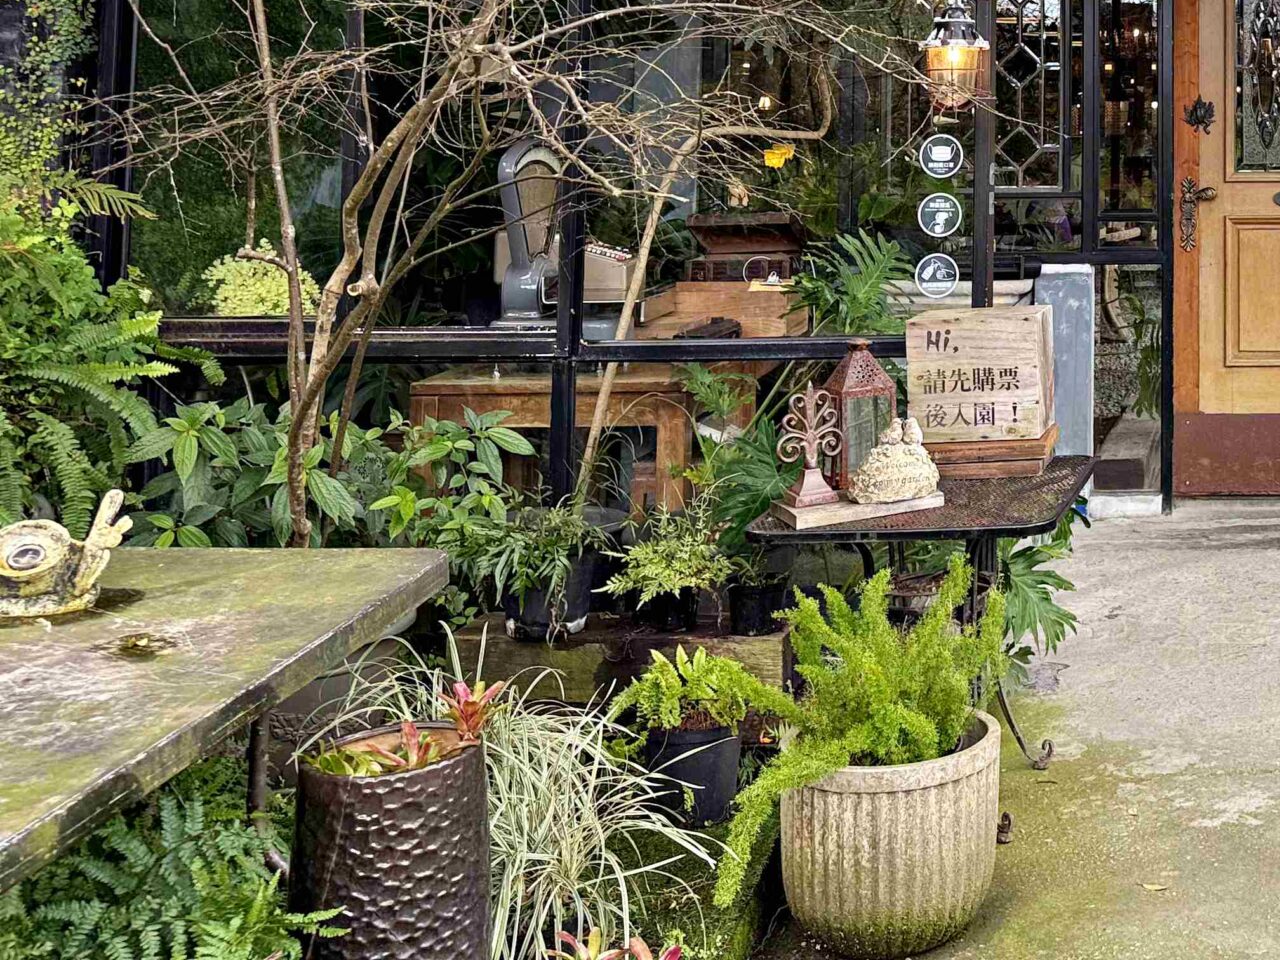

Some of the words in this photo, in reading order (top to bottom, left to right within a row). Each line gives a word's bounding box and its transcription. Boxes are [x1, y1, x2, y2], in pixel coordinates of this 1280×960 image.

[926, 329, 959, 353] Hi,
[922, 366, 1020, 394] 請先購票
[901, 473, 931, 487] garden
